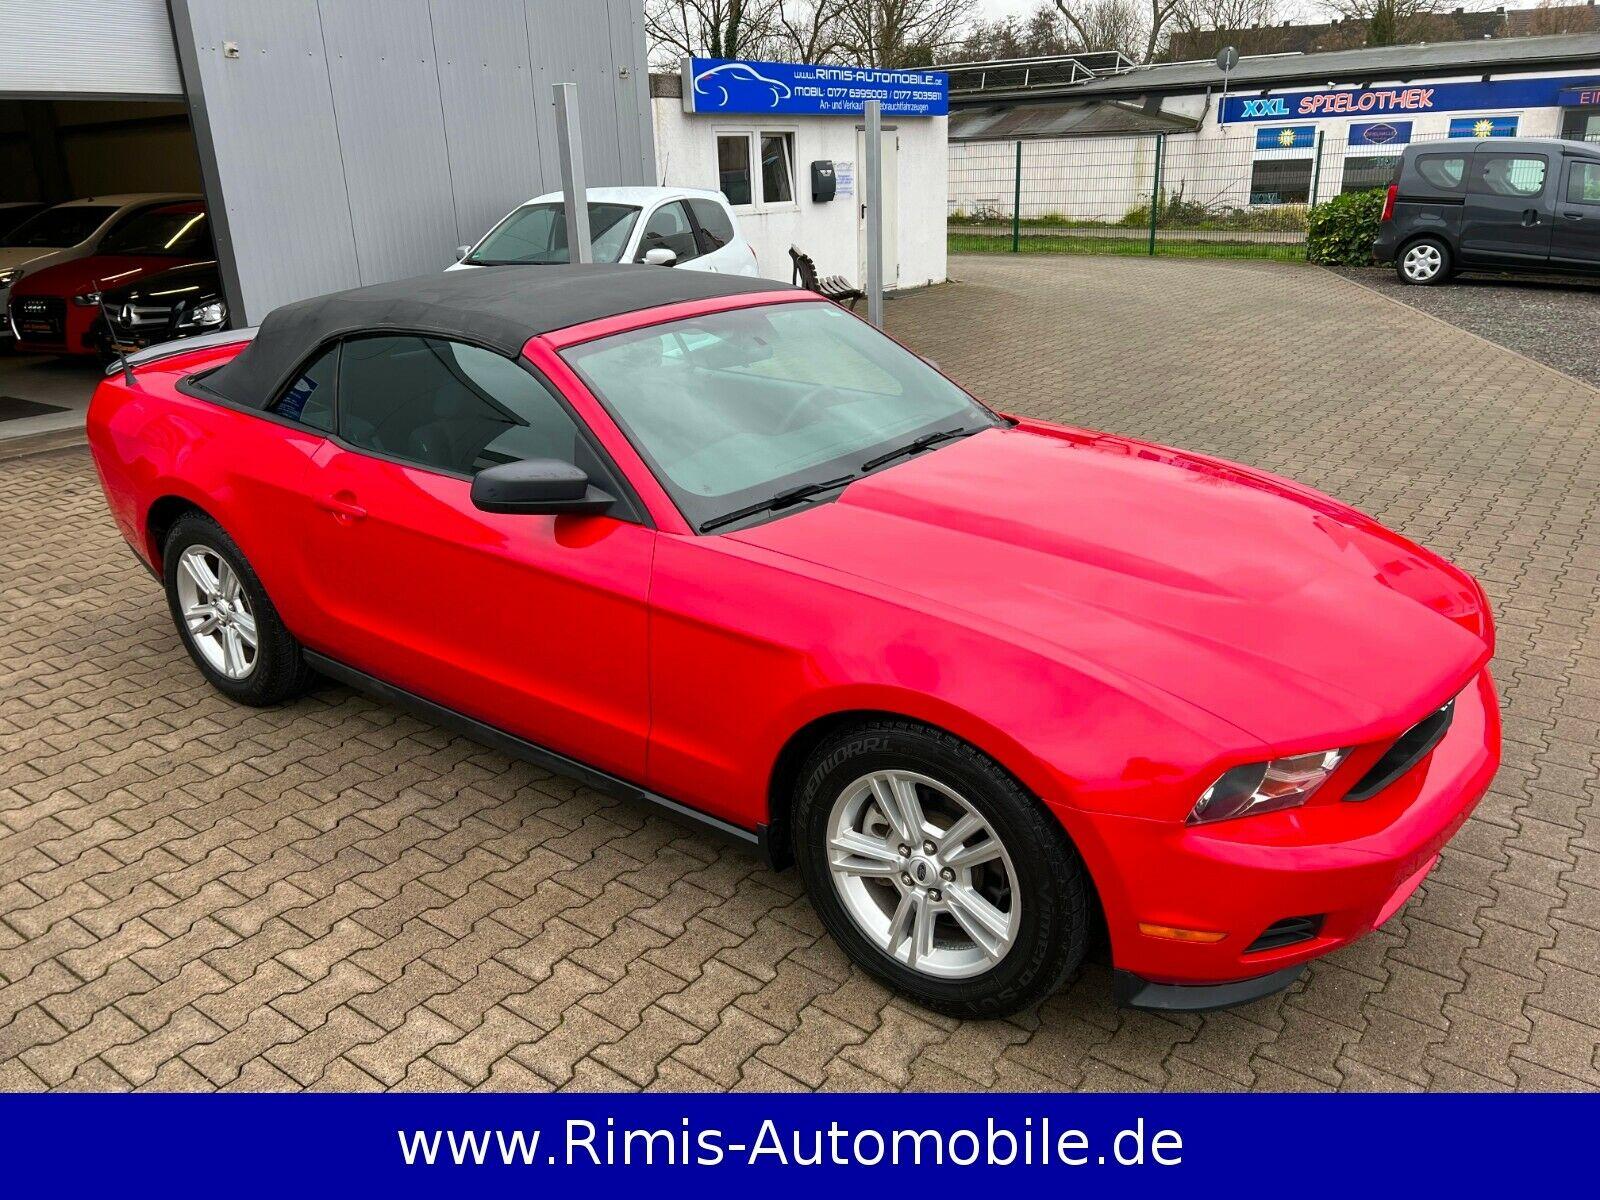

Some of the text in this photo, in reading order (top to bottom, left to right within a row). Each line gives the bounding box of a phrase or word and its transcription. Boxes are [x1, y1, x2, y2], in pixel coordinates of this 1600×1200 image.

[794, 86, 826, 97] MOBIL:
[827, 87, 848, 98] 0177
[849, 88, 888, 99] 6395003
[893, 90, 911, 100] 0177
[912, 91, 942, 101] 5035811
[820, 100, 929, 114] An- und Verkauf ebrauchtfahrzeugen
[1241, 88, 1435, 118] XXL SPIELOTHEK
